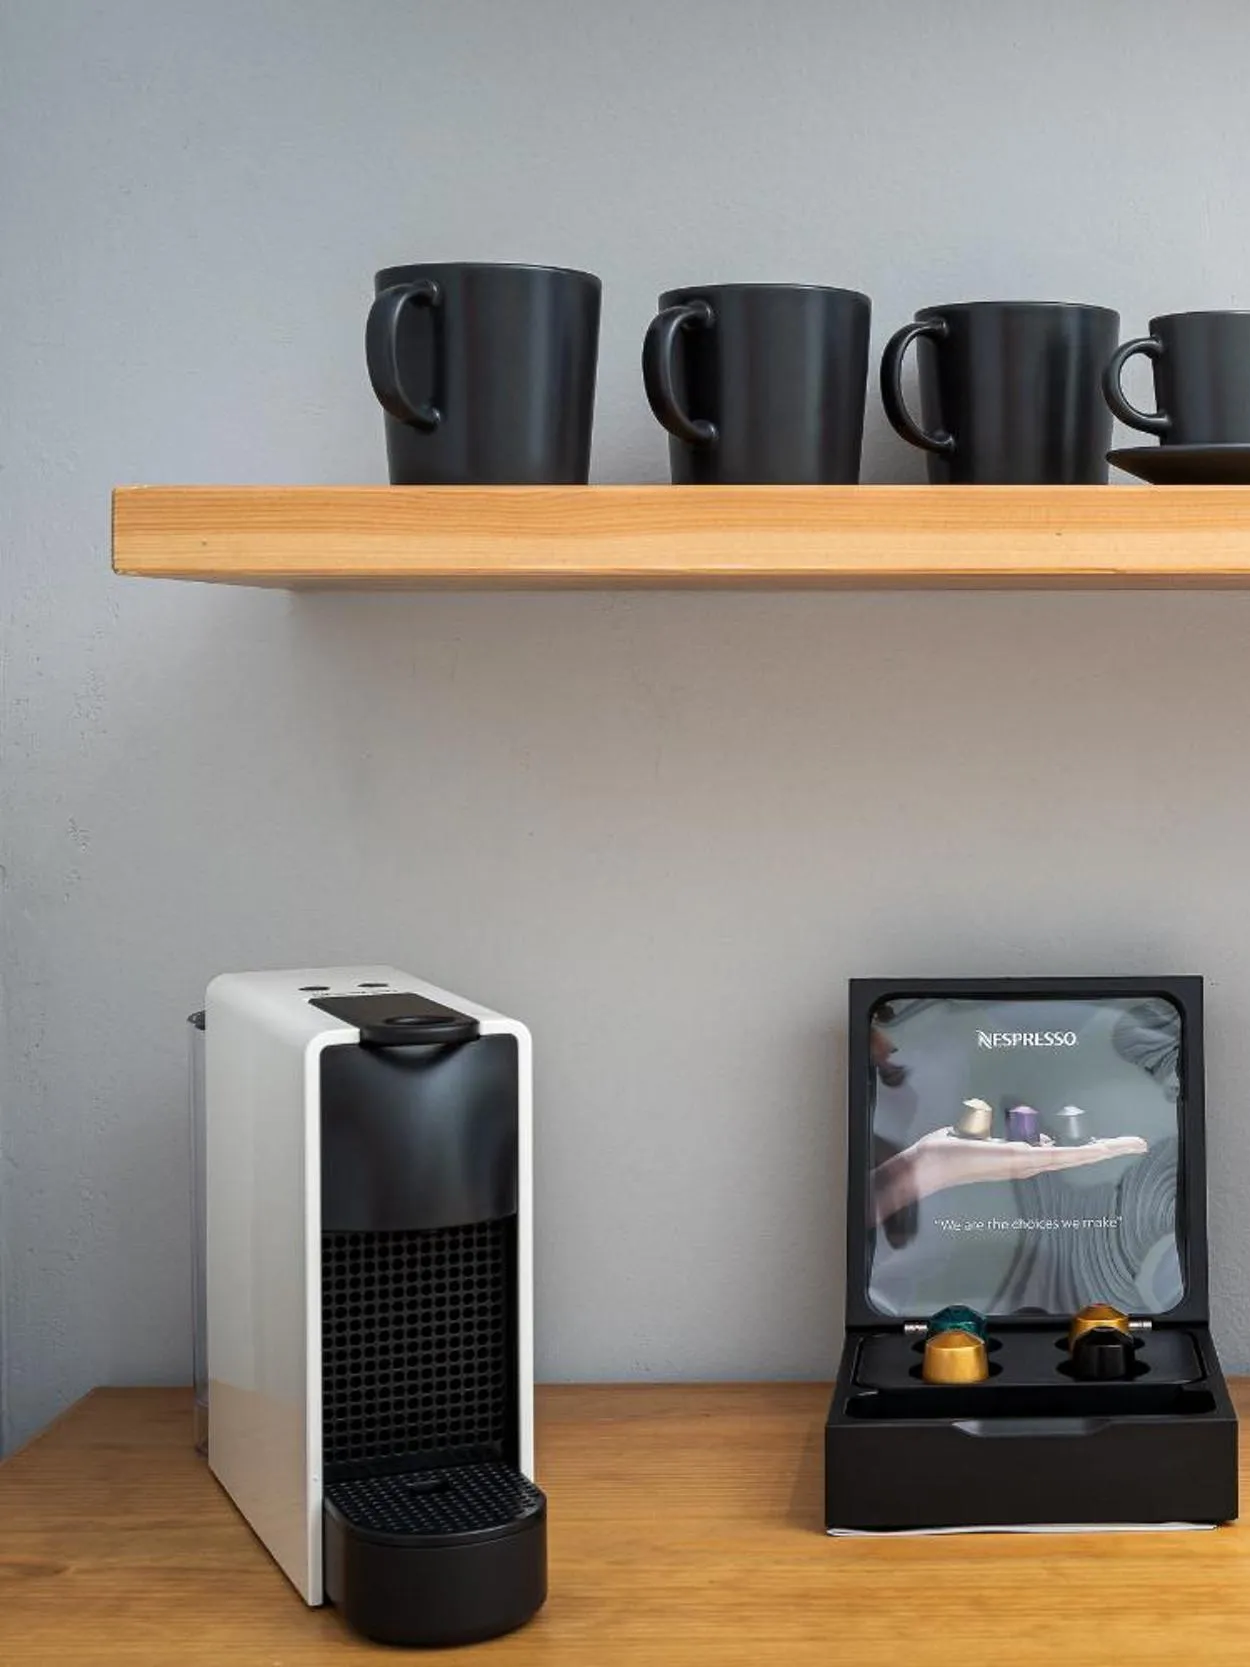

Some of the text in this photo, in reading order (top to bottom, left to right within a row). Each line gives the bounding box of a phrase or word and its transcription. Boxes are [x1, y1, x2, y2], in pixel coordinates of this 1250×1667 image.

[976, 1030, 1077, 1049] NESPRESSO
[964, 1221, 984, 1231] are
[987, 1217, 1009, 1230] the
[1011, 1218, 1060, 1230] choices
[1060, 1219, 1080, 1230] we
